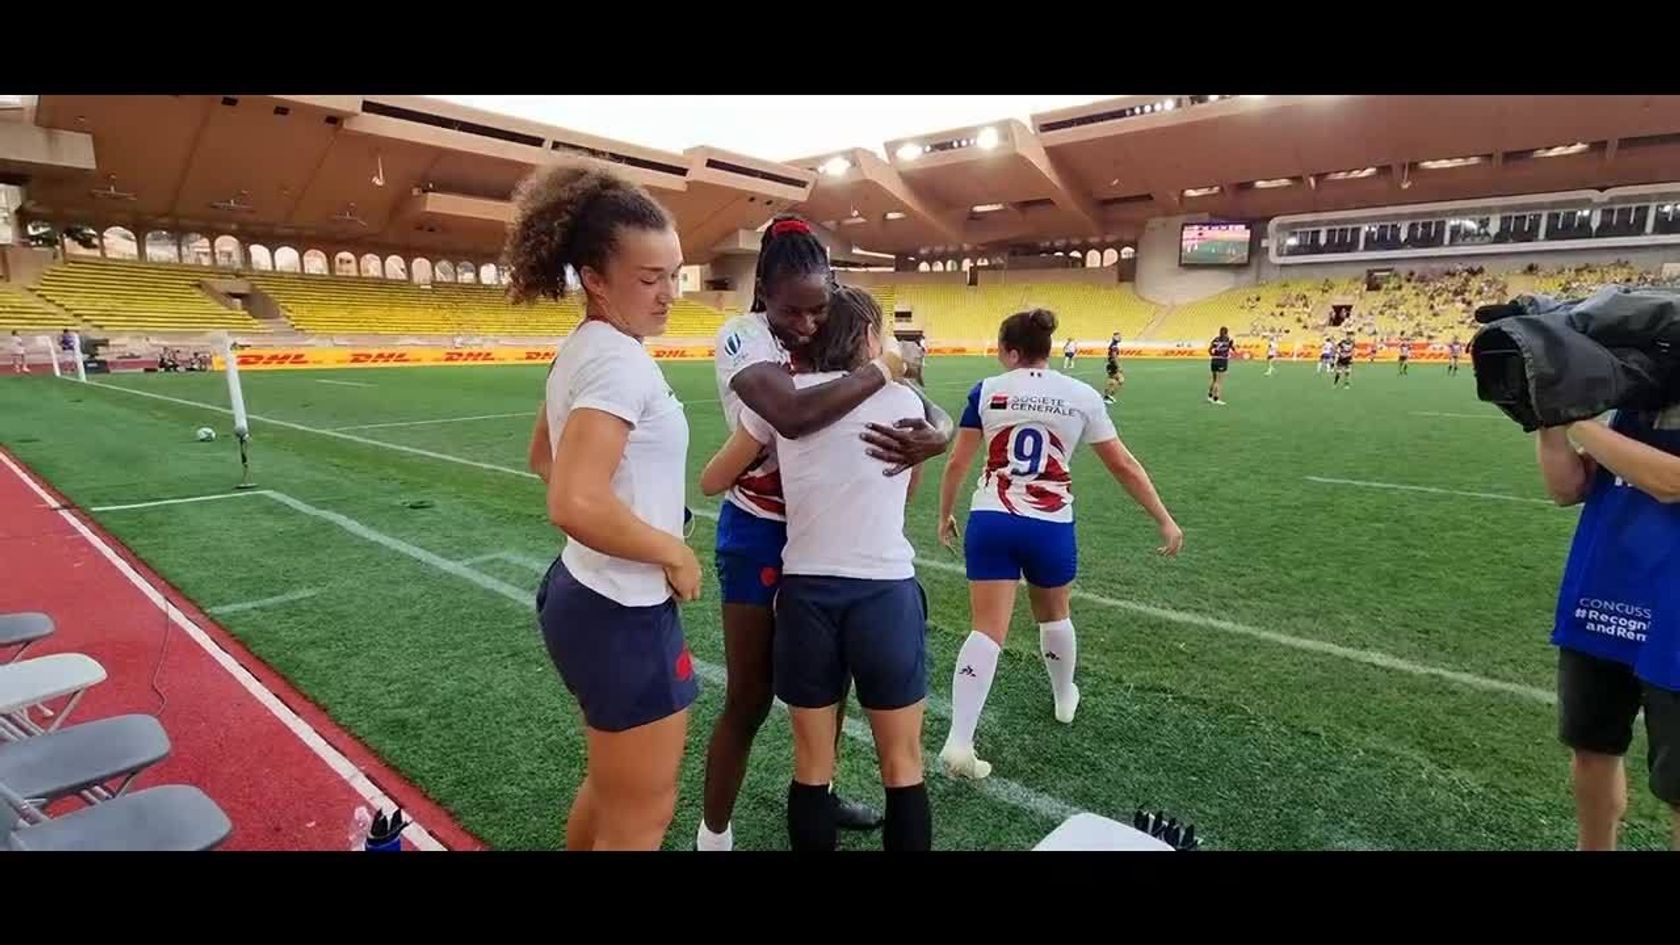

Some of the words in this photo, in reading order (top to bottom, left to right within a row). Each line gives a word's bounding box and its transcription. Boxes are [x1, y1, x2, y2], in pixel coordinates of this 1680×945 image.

[236, 354, 308, 365] DHL
[350, 353, 409, 363] DHL
[444, 352, 495, 361] DHL
[525, 351, 556, 360] DH
[1011, 403, 1074, 417] GENERALE
[1012, 427, 1043, 476] 9
[1579, 598, 1652, 619] CONCUSS
